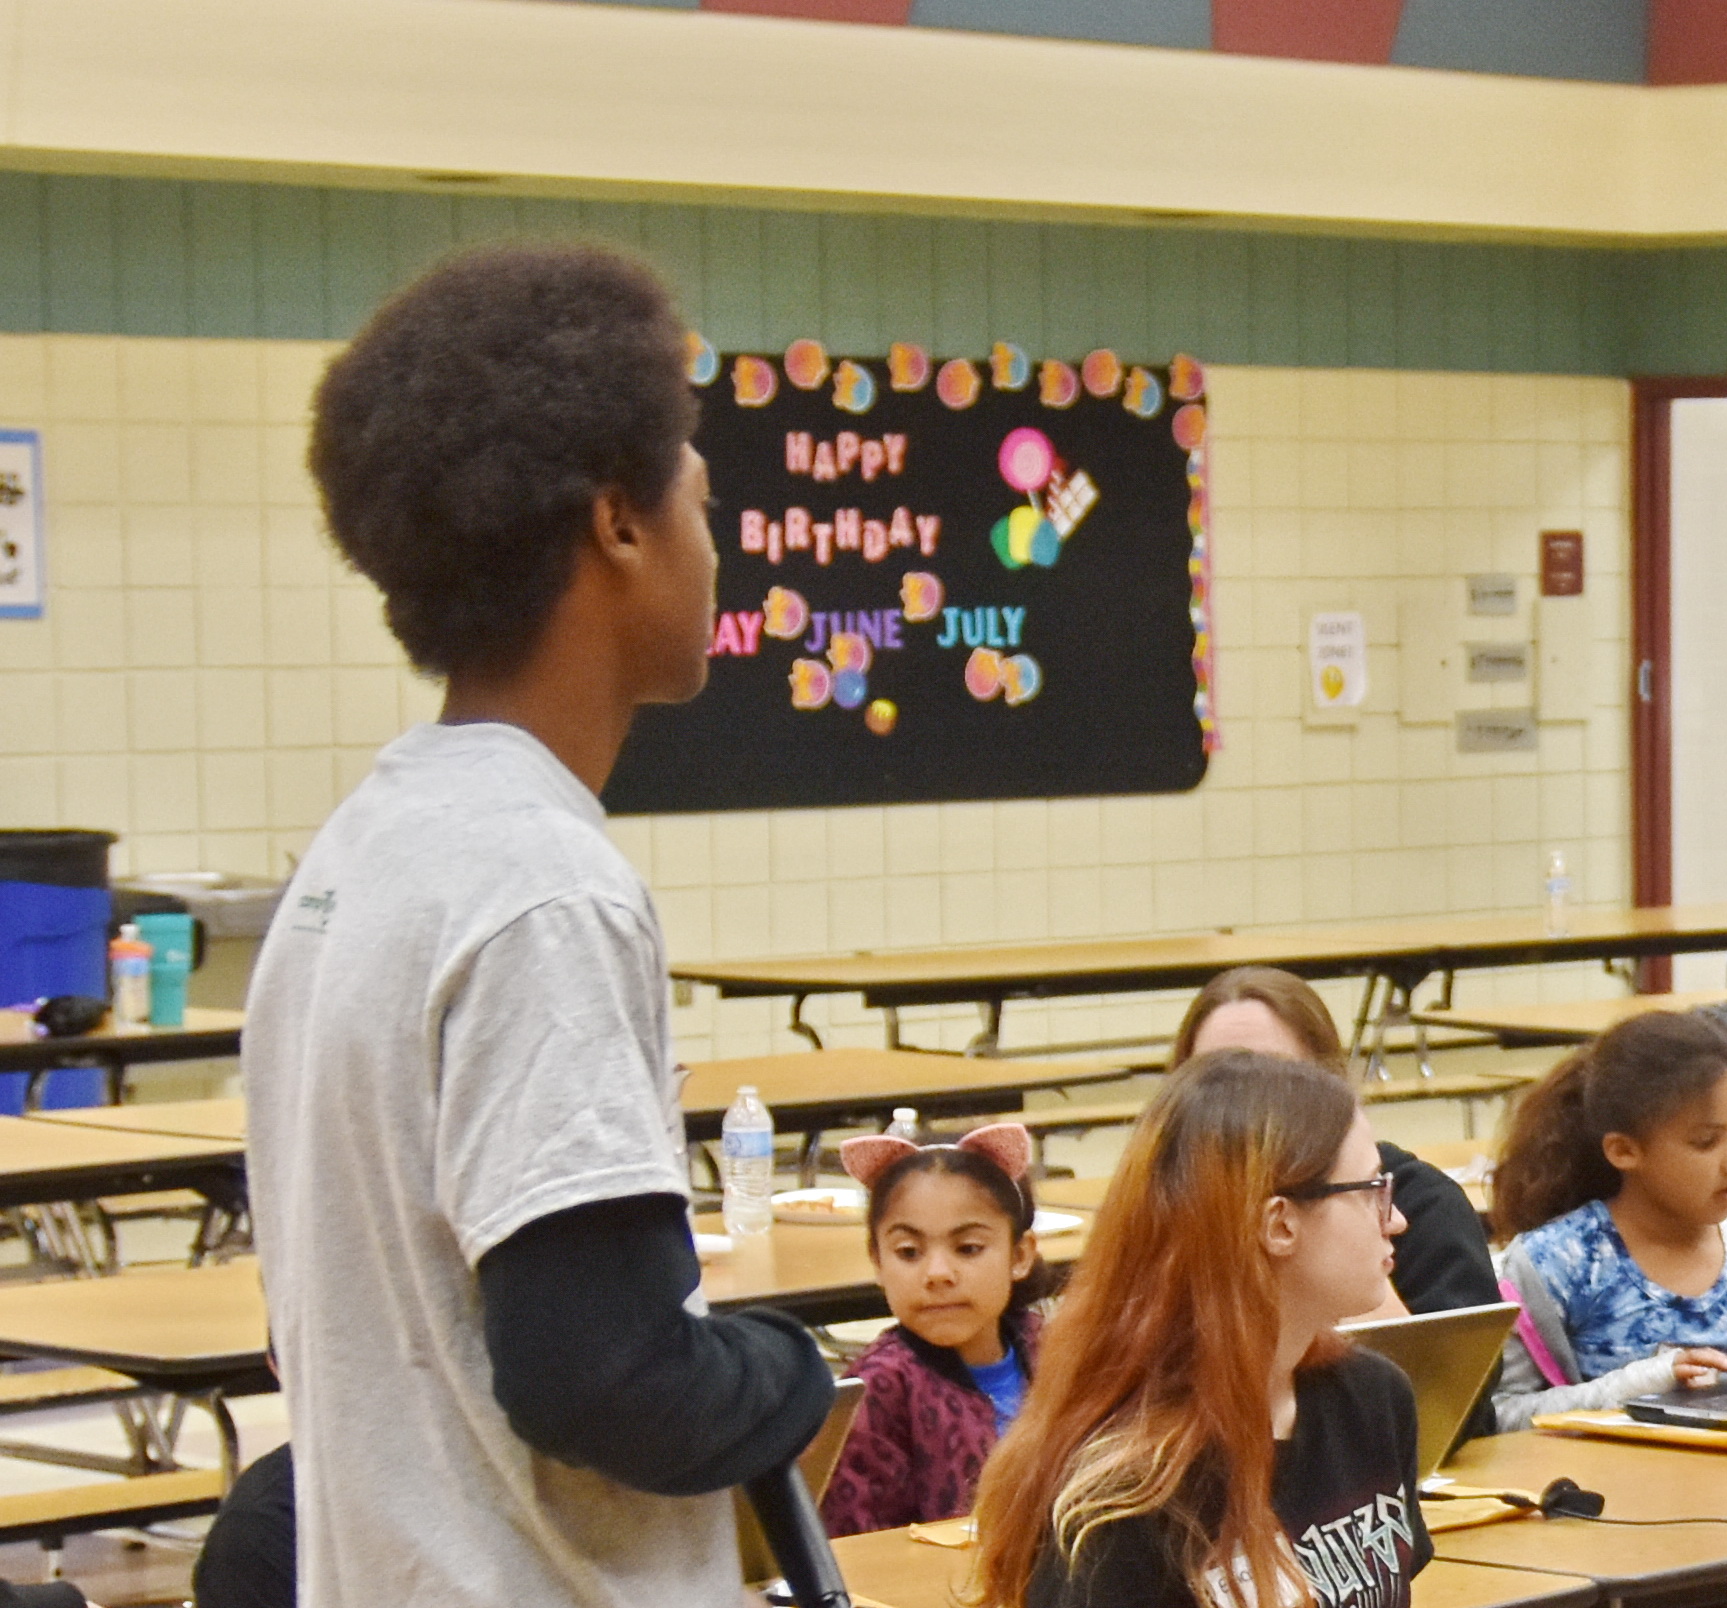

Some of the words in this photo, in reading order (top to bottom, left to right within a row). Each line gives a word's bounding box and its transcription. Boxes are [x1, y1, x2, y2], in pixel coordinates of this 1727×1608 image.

[785, 430, 908, 481] HAPPY
[740, 506, 941, 565] BIRTHDAY
[706, 610, 764, 656] AY
[804, 608, 903, 652] JUNE
[936, 606, 1026, 648] JULY
